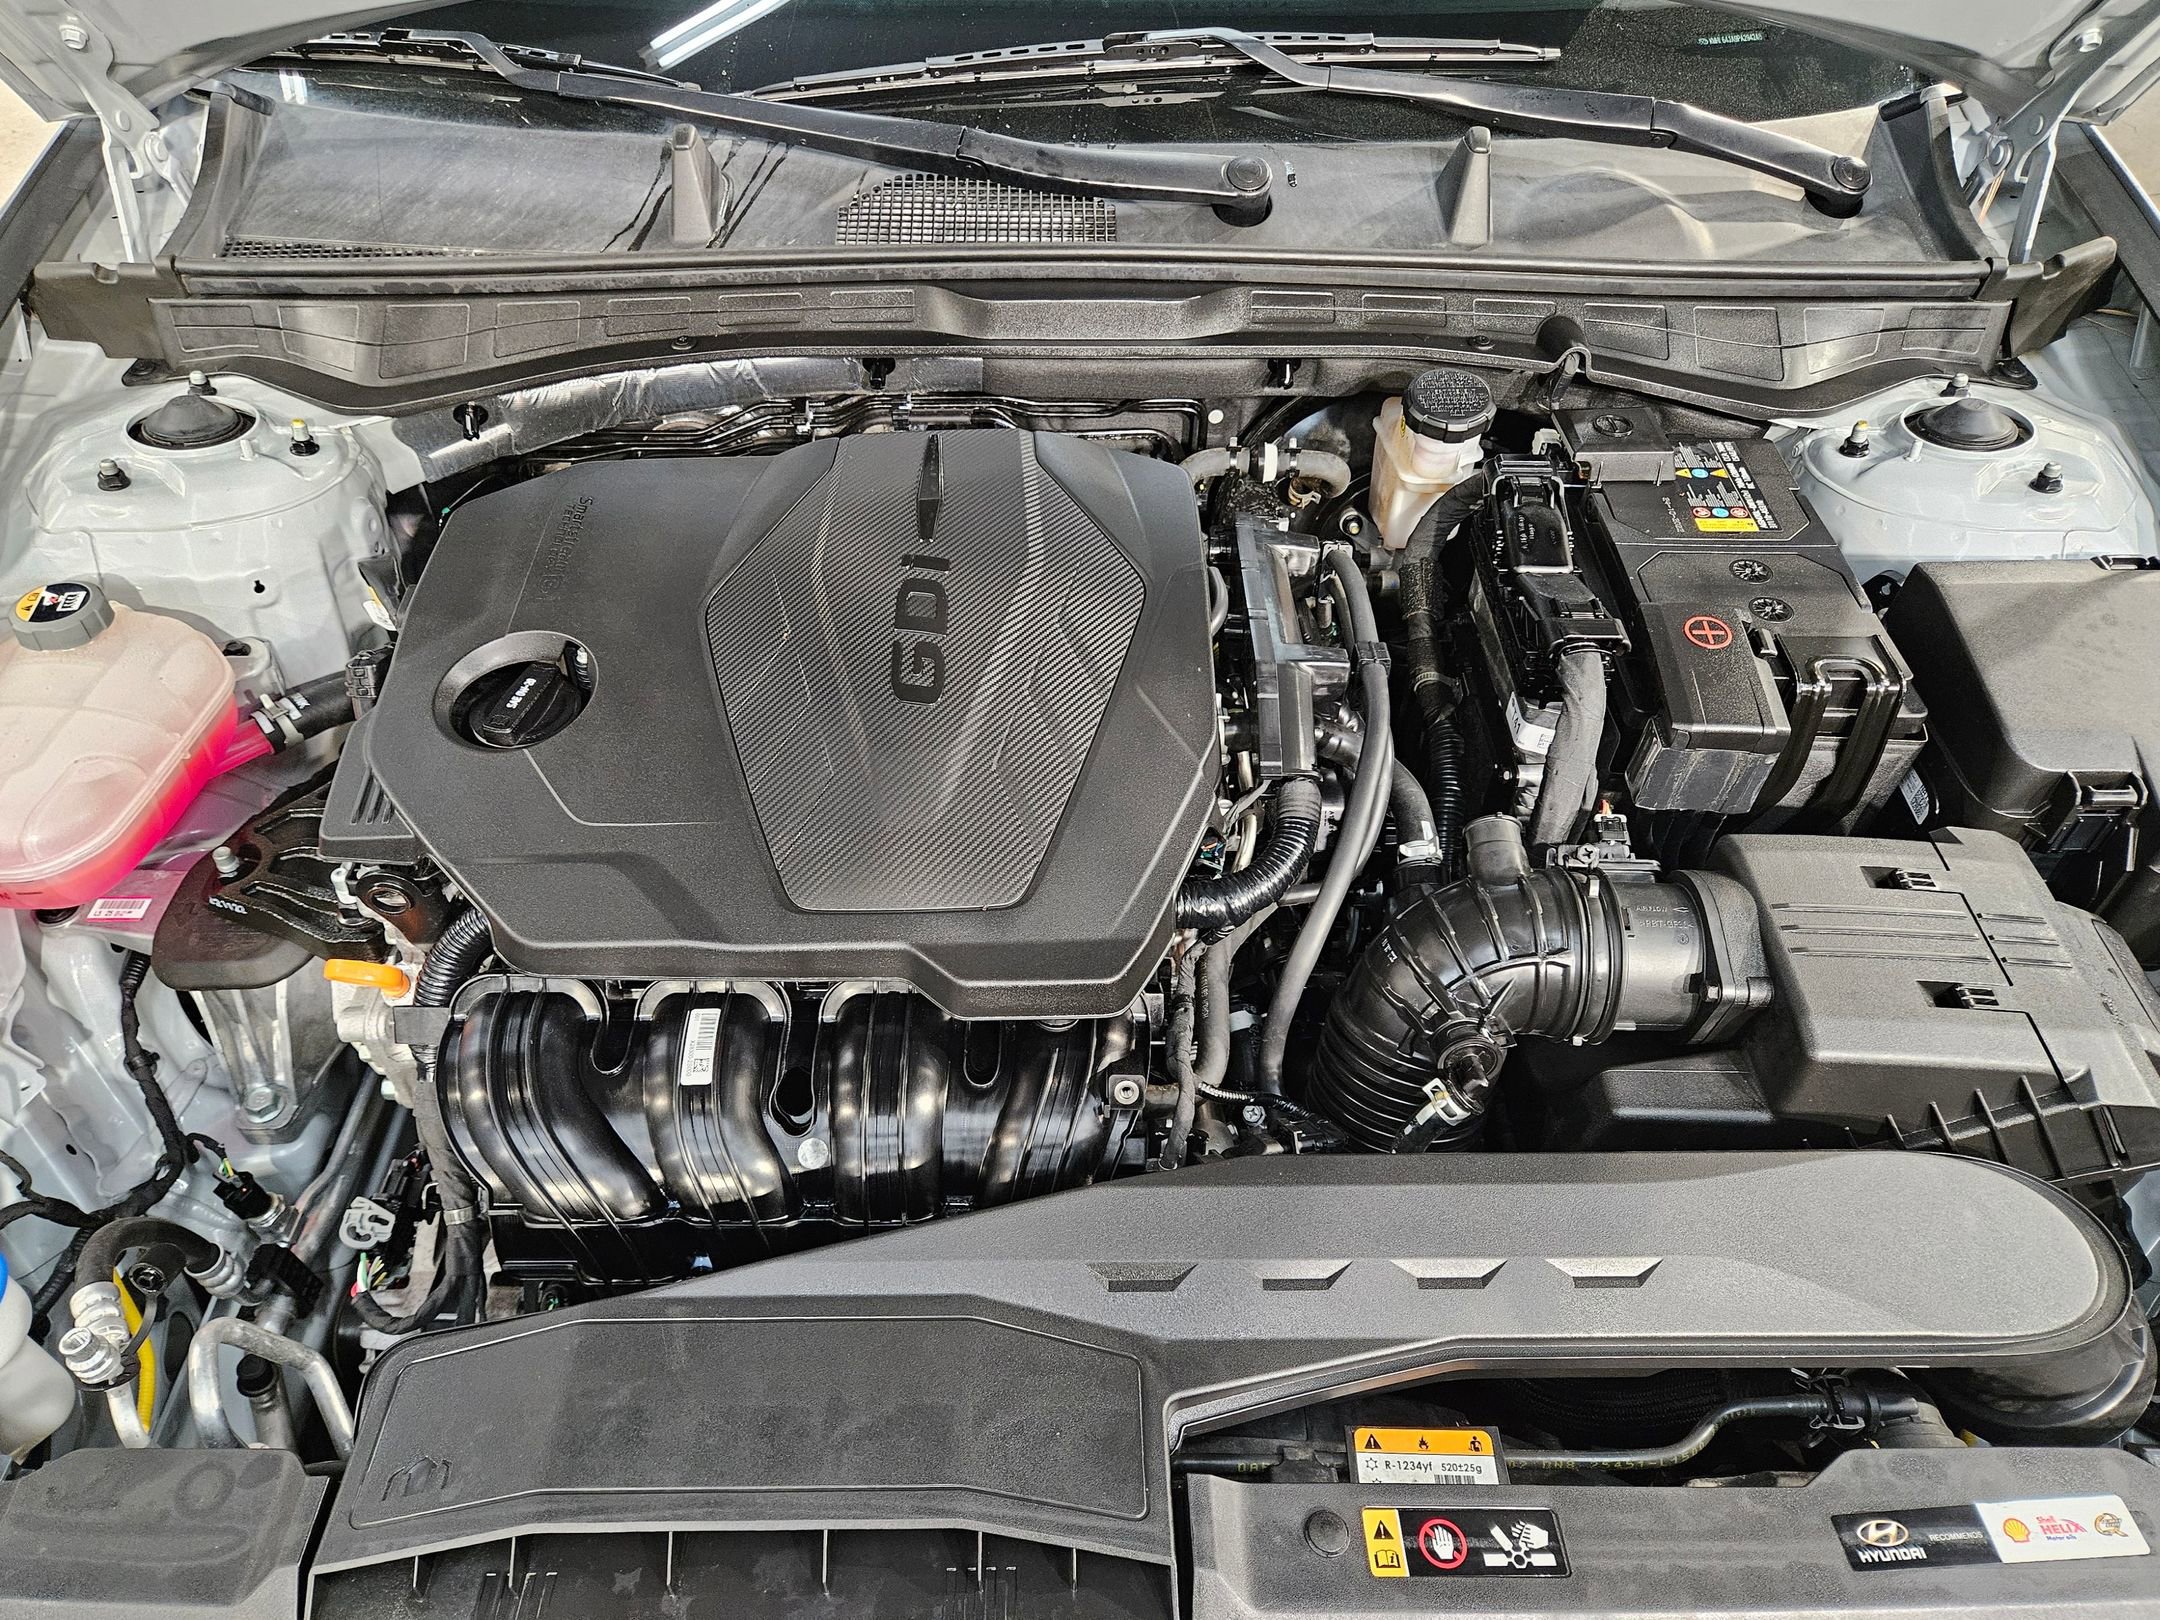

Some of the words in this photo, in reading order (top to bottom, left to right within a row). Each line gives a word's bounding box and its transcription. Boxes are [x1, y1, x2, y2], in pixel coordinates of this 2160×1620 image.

[1384, 1460, 1433, 1473] R-1234yf
[1441, 1462, 1482, 1474] 520±25g
[2036, 1515, 2057, 1524] Shell
[2040, 1519, 2088, 1535] HELIX
[1858, 1547, 1928, 1564] HYUNDAI
